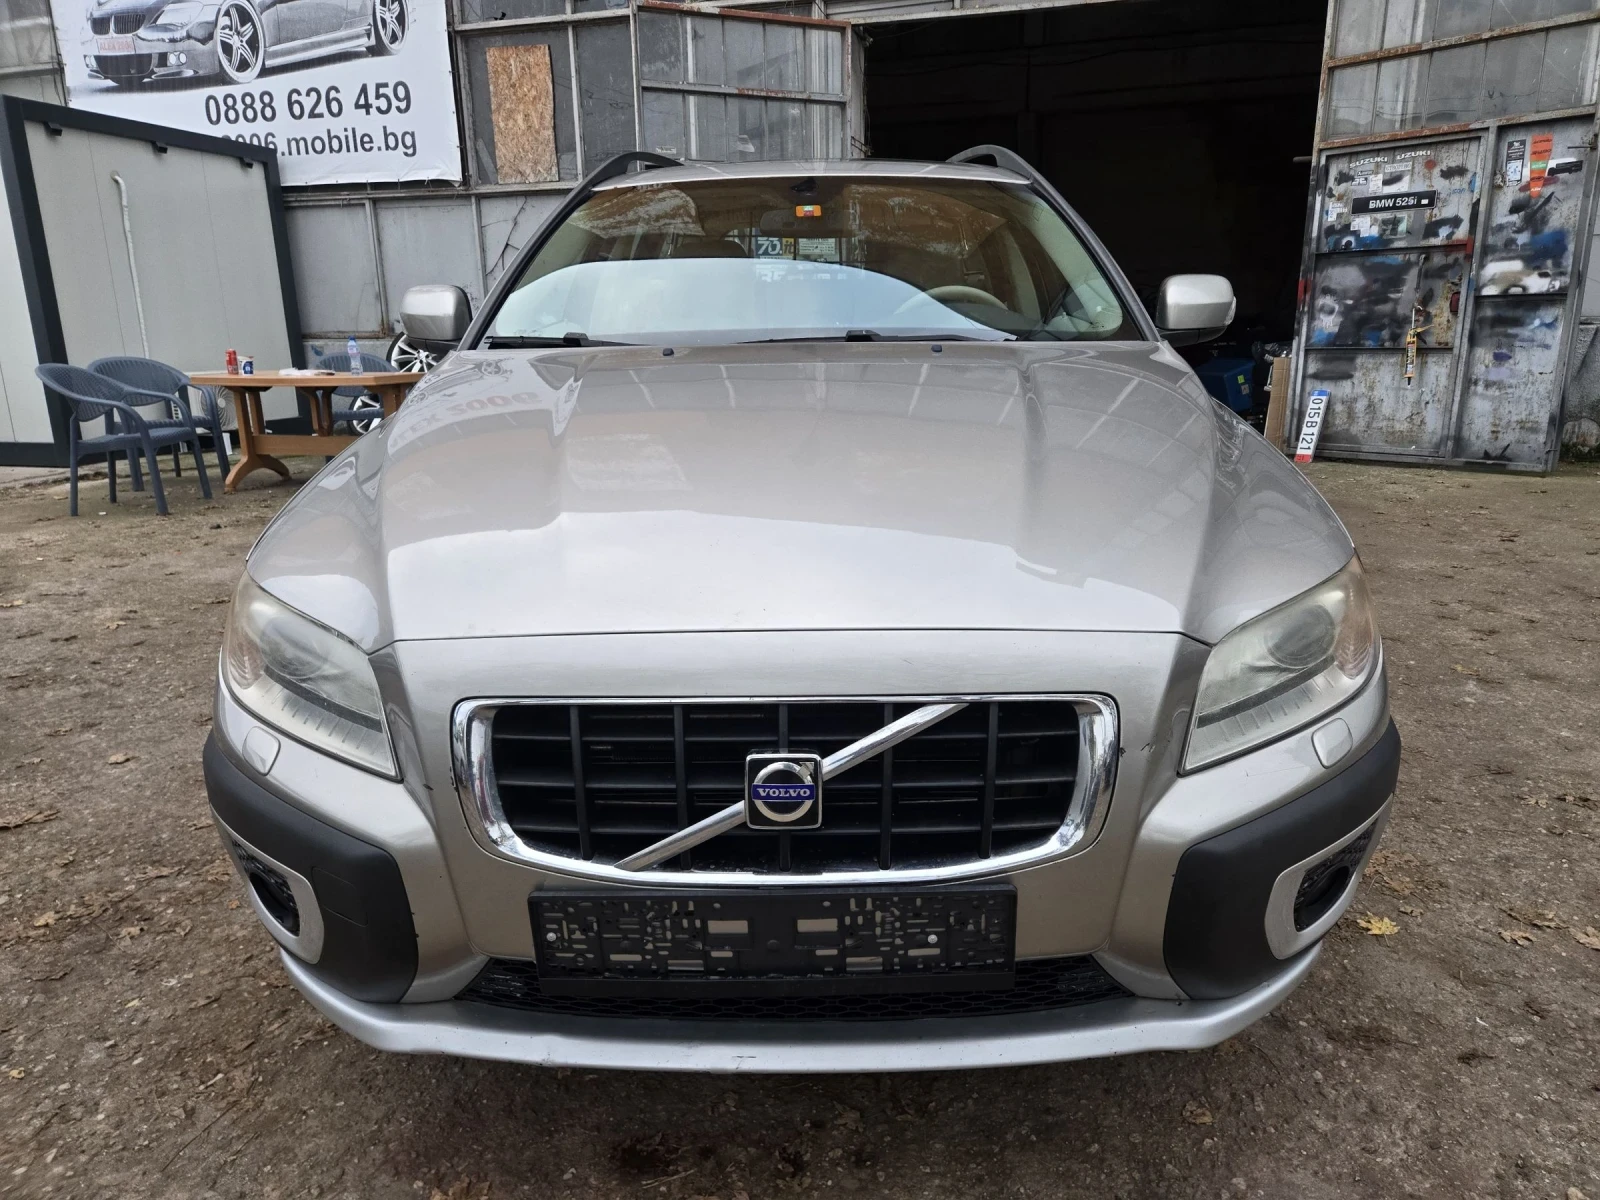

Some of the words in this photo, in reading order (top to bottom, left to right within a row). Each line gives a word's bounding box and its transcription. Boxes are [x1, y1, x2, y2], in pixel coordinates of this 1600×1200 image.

[205, 90, 277, 126] 0888
[287, 85, 343, 120] 626
[354, 80, 412, 116] 459
[1396, 150, 1431, 160] UZUKI
[1349, 156, 1388, 169] SUZUKI
[1368, 197, 1394, 209] BMW
[1396, 196, 1418, 207] 525i
[756, 788, 810, 797] VOLVO
